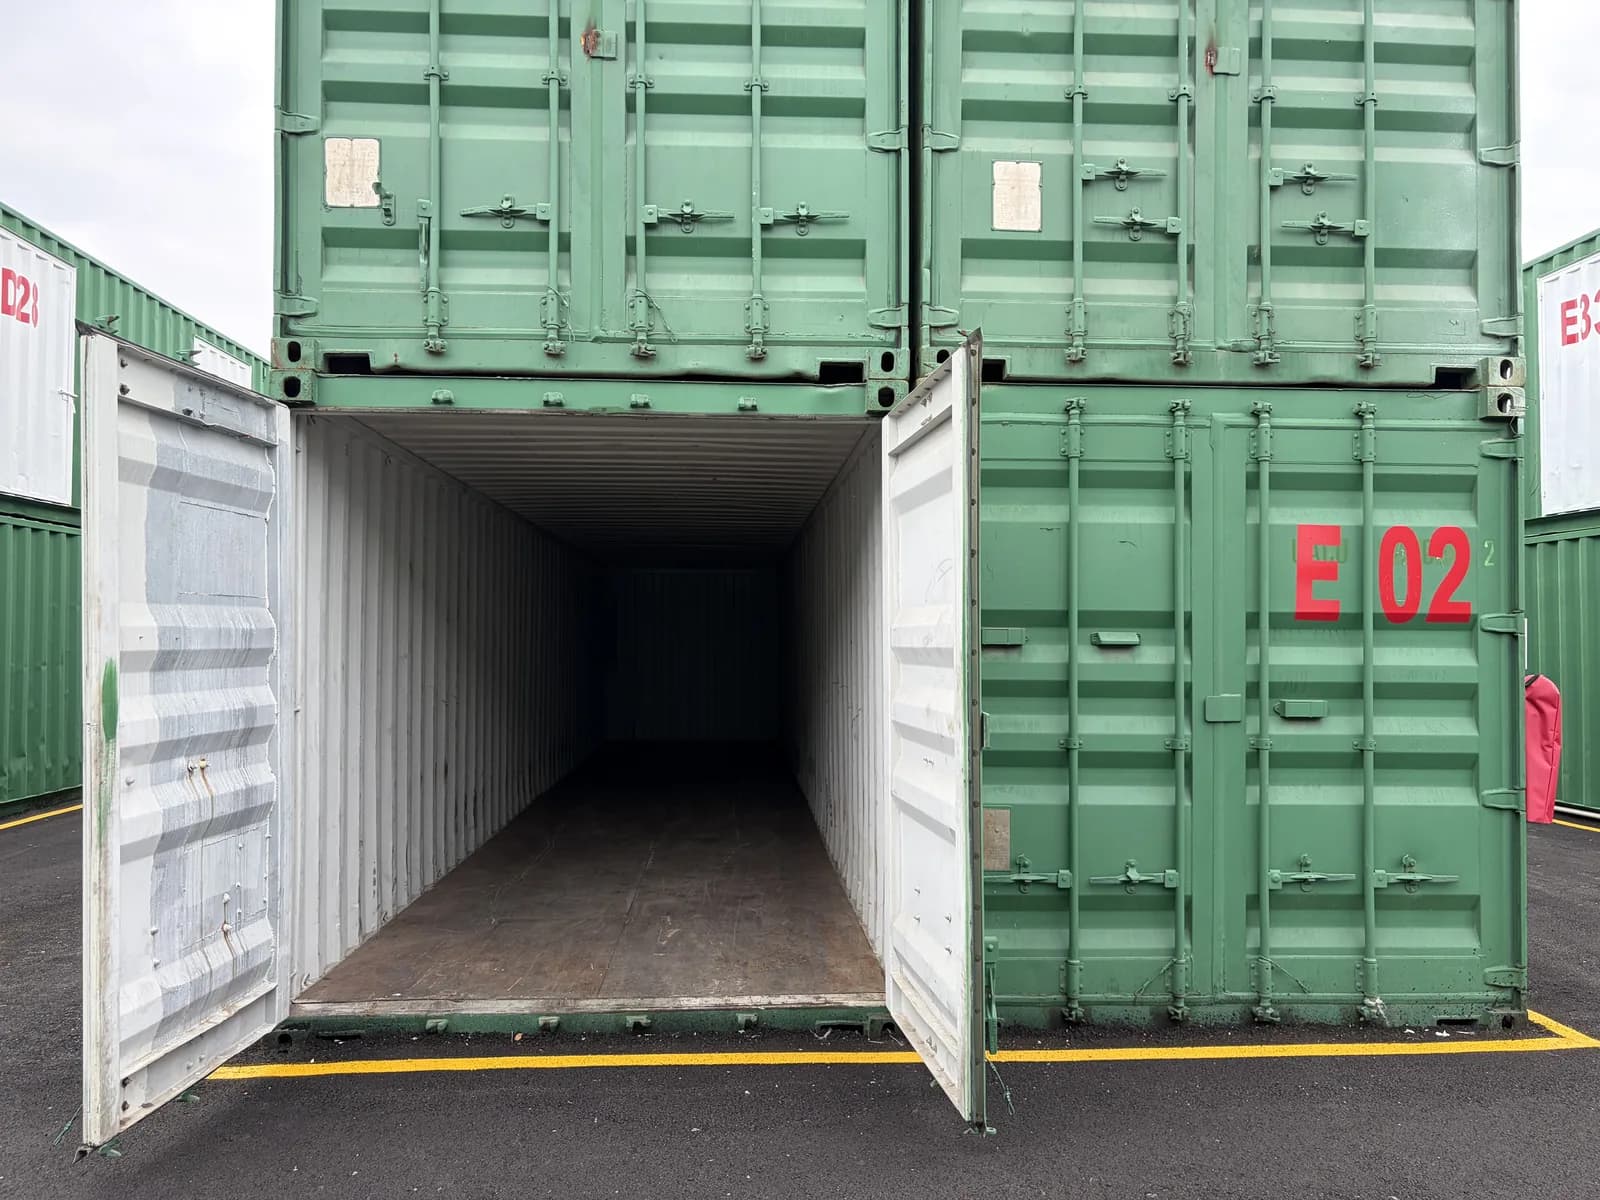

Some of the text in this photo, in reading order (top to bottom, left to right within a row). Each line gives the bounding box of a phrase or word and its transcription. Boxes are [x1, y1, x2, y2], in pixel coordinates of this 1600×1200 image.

[1, 267, 39, 328] D28
[1294, 524, 1472, 624] E 02
